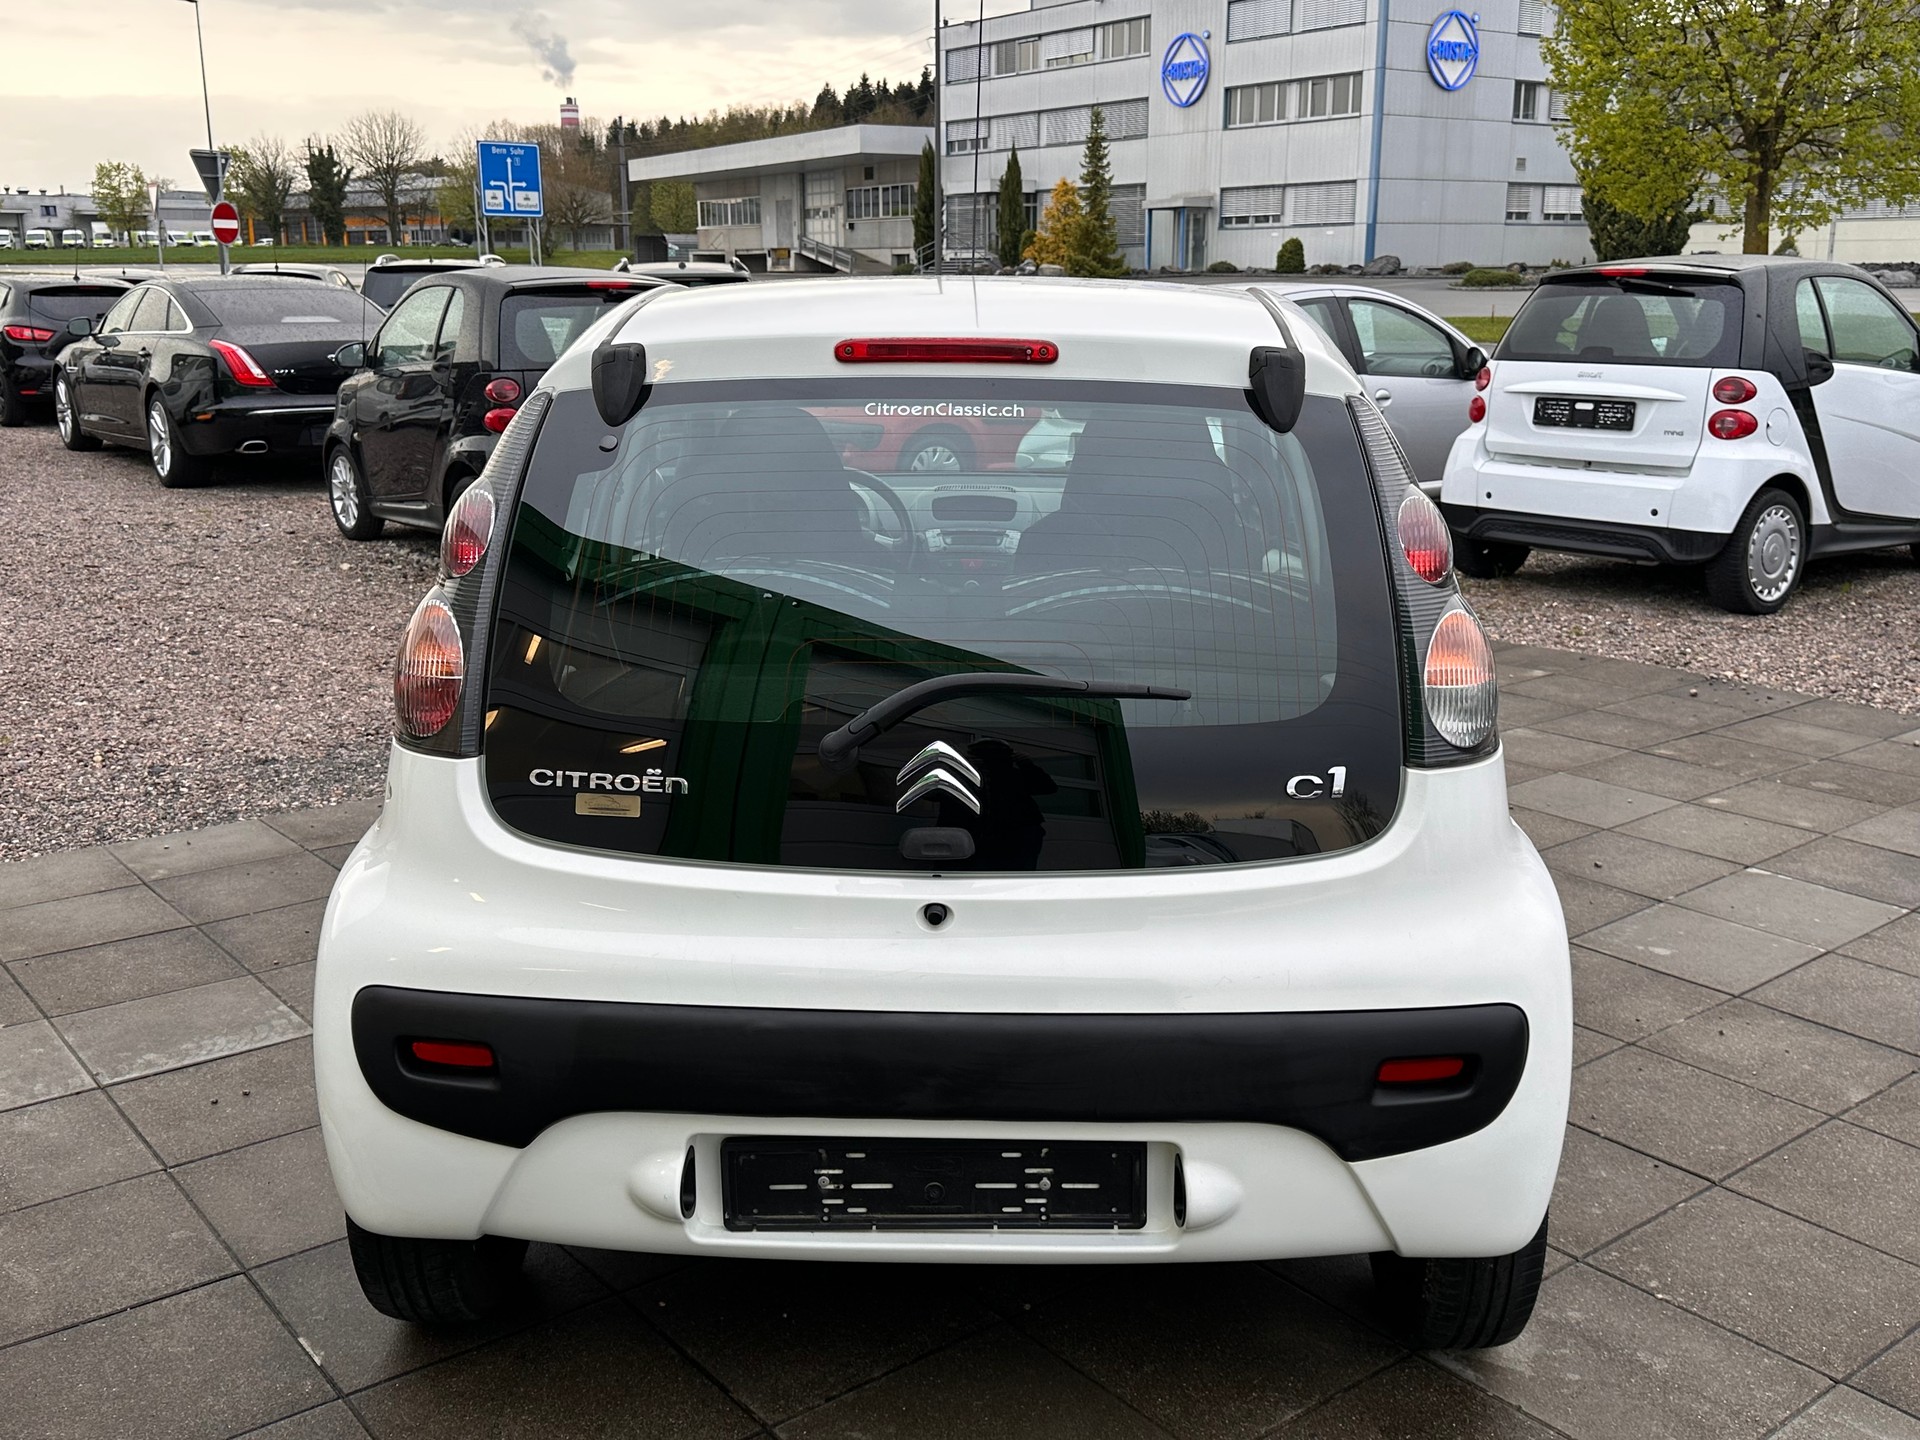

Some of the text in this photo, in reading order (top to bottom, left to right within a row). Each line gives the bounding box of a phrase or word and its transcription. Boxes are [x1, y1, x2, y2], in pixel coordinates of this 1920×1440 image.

[491, 146, 525, 156] Bern Suhr
[864, 402, 1025, 418] CitroenClassic.ch
